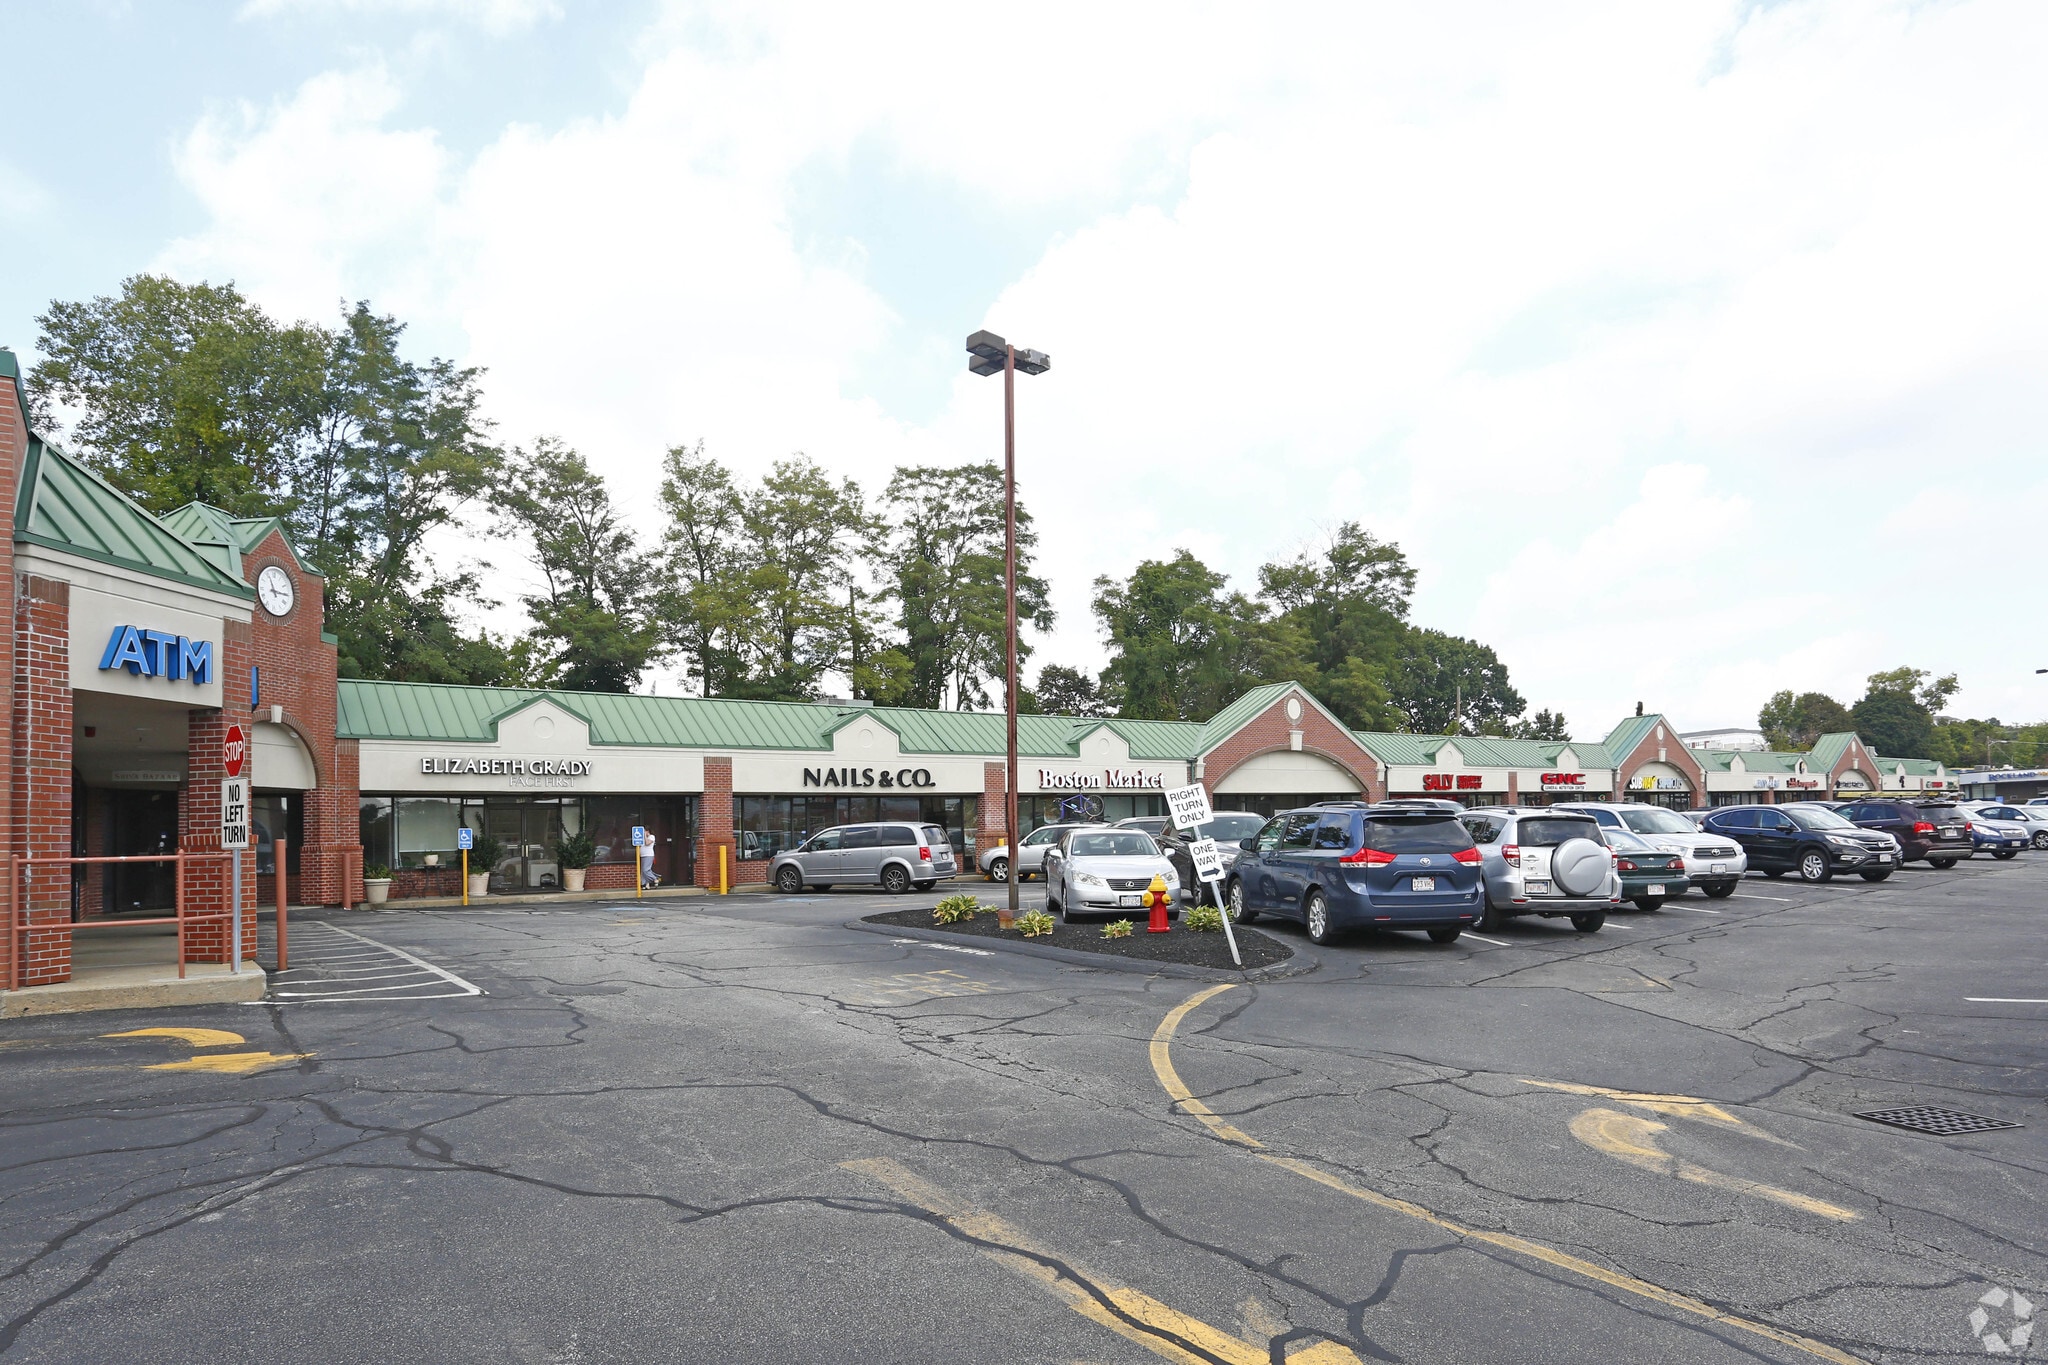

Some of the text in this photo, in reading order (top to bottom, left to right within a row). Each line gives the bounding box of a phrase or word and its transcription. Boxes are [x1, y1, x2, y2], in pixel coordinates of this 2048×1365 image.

[99, 625, 213, 684] ATM
[225, 741, 243, 762] STOP
[421, 758, 593, 776] ELIZABETH GRADY
[509, 777, 576, 788] FACE FIRST
[1039, 769, 1167, 789] Boston Market
[1423, 774, 1454, 791] SALLY
[1541, 773, 1586, 785] GNC
[229, 784, 240, 802] NO
[1169, 787, 1200, 802] RIGHT
[225, 804, 244, 823] LEFT
[1175, 799, 1204, 812] TURN
[1179, 811, 1205, 824] ONLY
[223, 825, 246, 843] TURN
[1193, 843, 1215, 856] ONE
[1196, 854, 1217, 866] WAY
